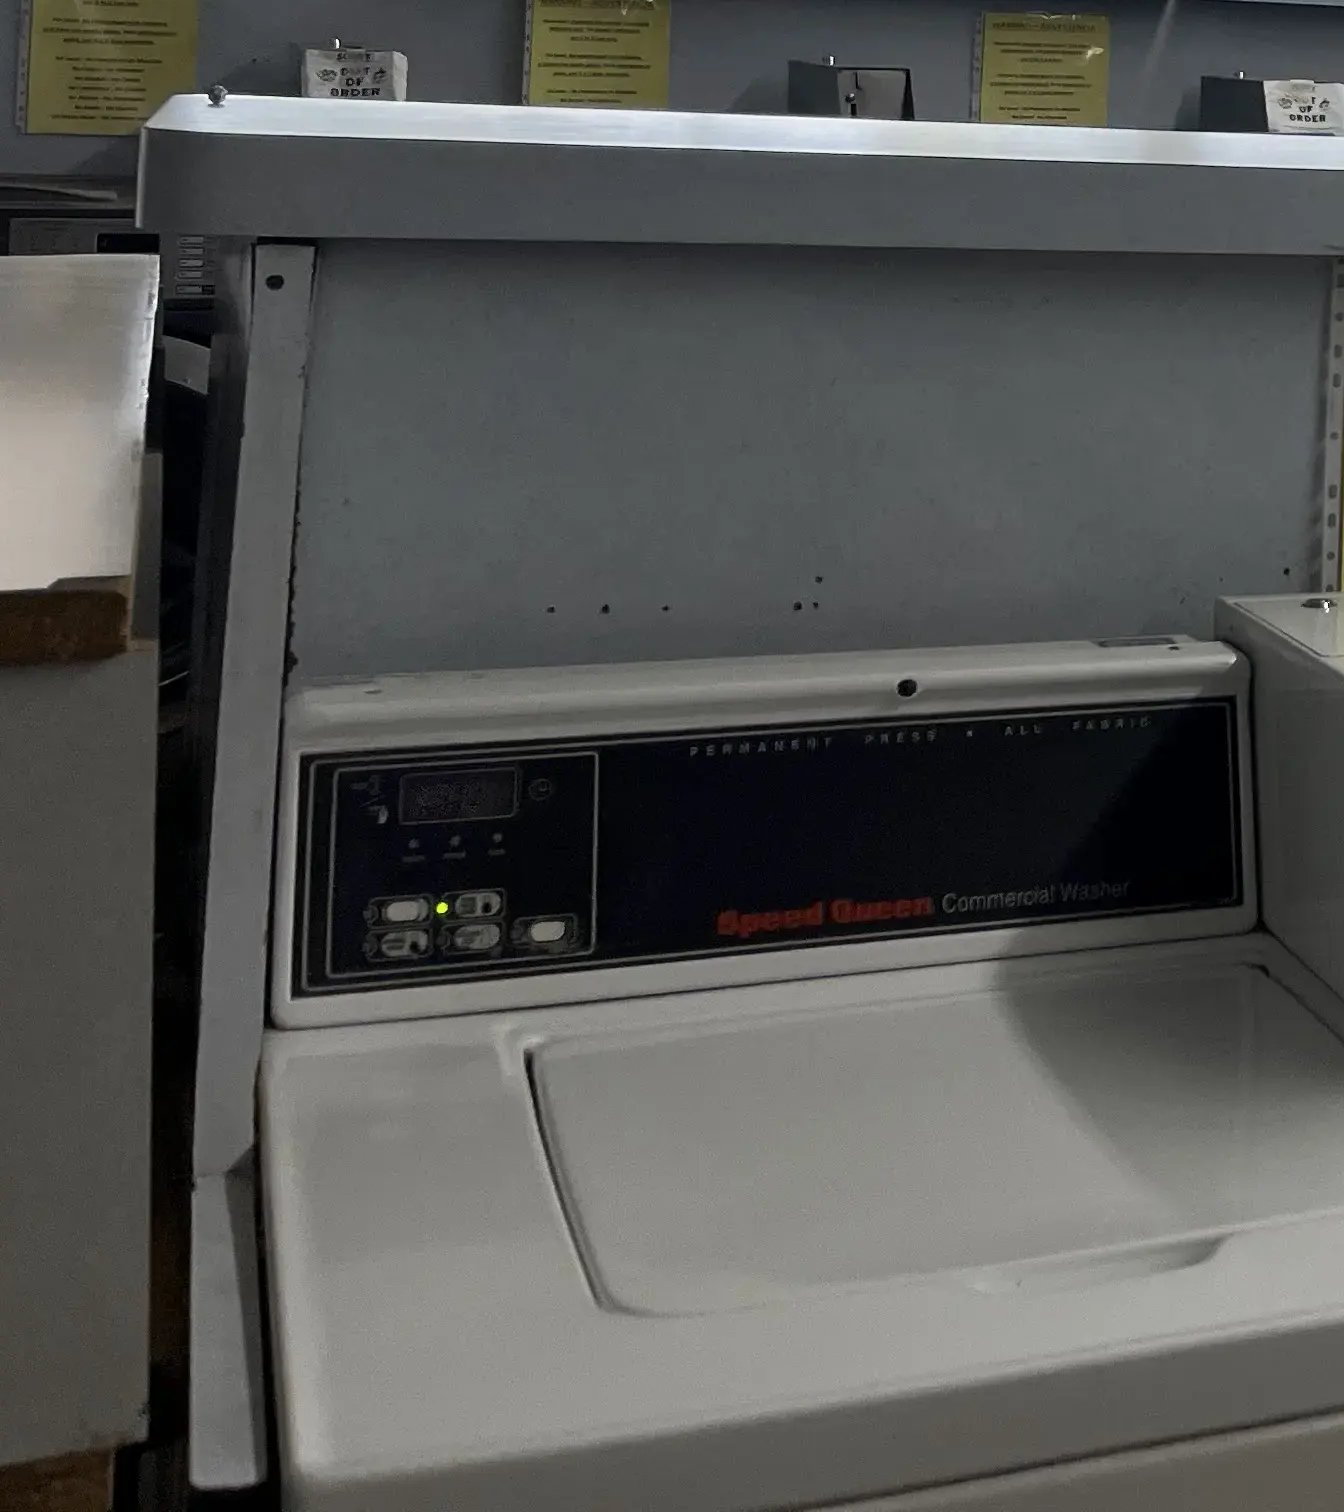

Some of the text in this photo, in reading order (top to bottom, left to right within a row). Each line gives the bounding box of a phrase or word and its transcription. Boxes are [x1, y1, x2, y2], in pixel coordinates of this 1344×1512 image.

[330, 87, 380, 97] ORDER
[1289, 114, 1326, 123] ORDER
[689, 716, 1150, 757] PERMANENT PRESS ALL FABRIC
[717, 880, 1131, 938] Speed Queen Commercial Washer
